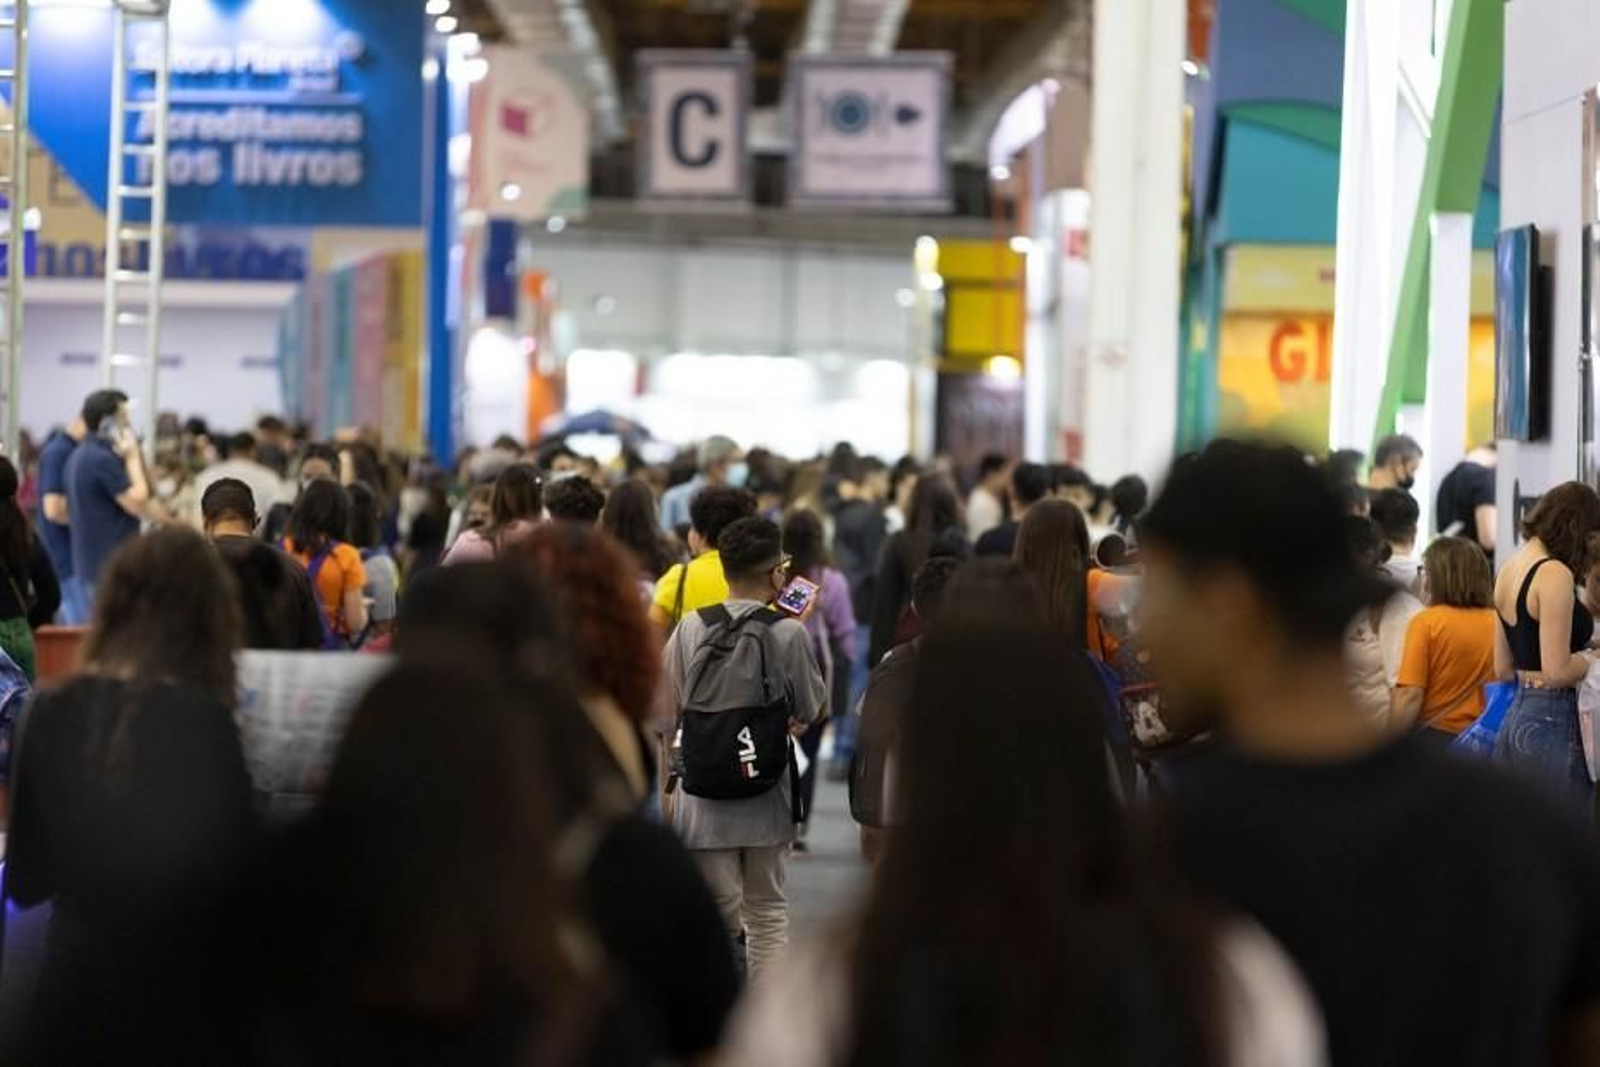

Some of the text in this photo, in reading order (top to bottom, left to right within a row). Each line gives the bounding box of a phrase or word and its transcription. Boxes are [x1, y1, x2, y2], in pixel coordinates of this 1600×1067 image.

[667, 91, 718, 168] C
[232, 142, 363, 187] livros
[737, 726, 759, 780] FILA
